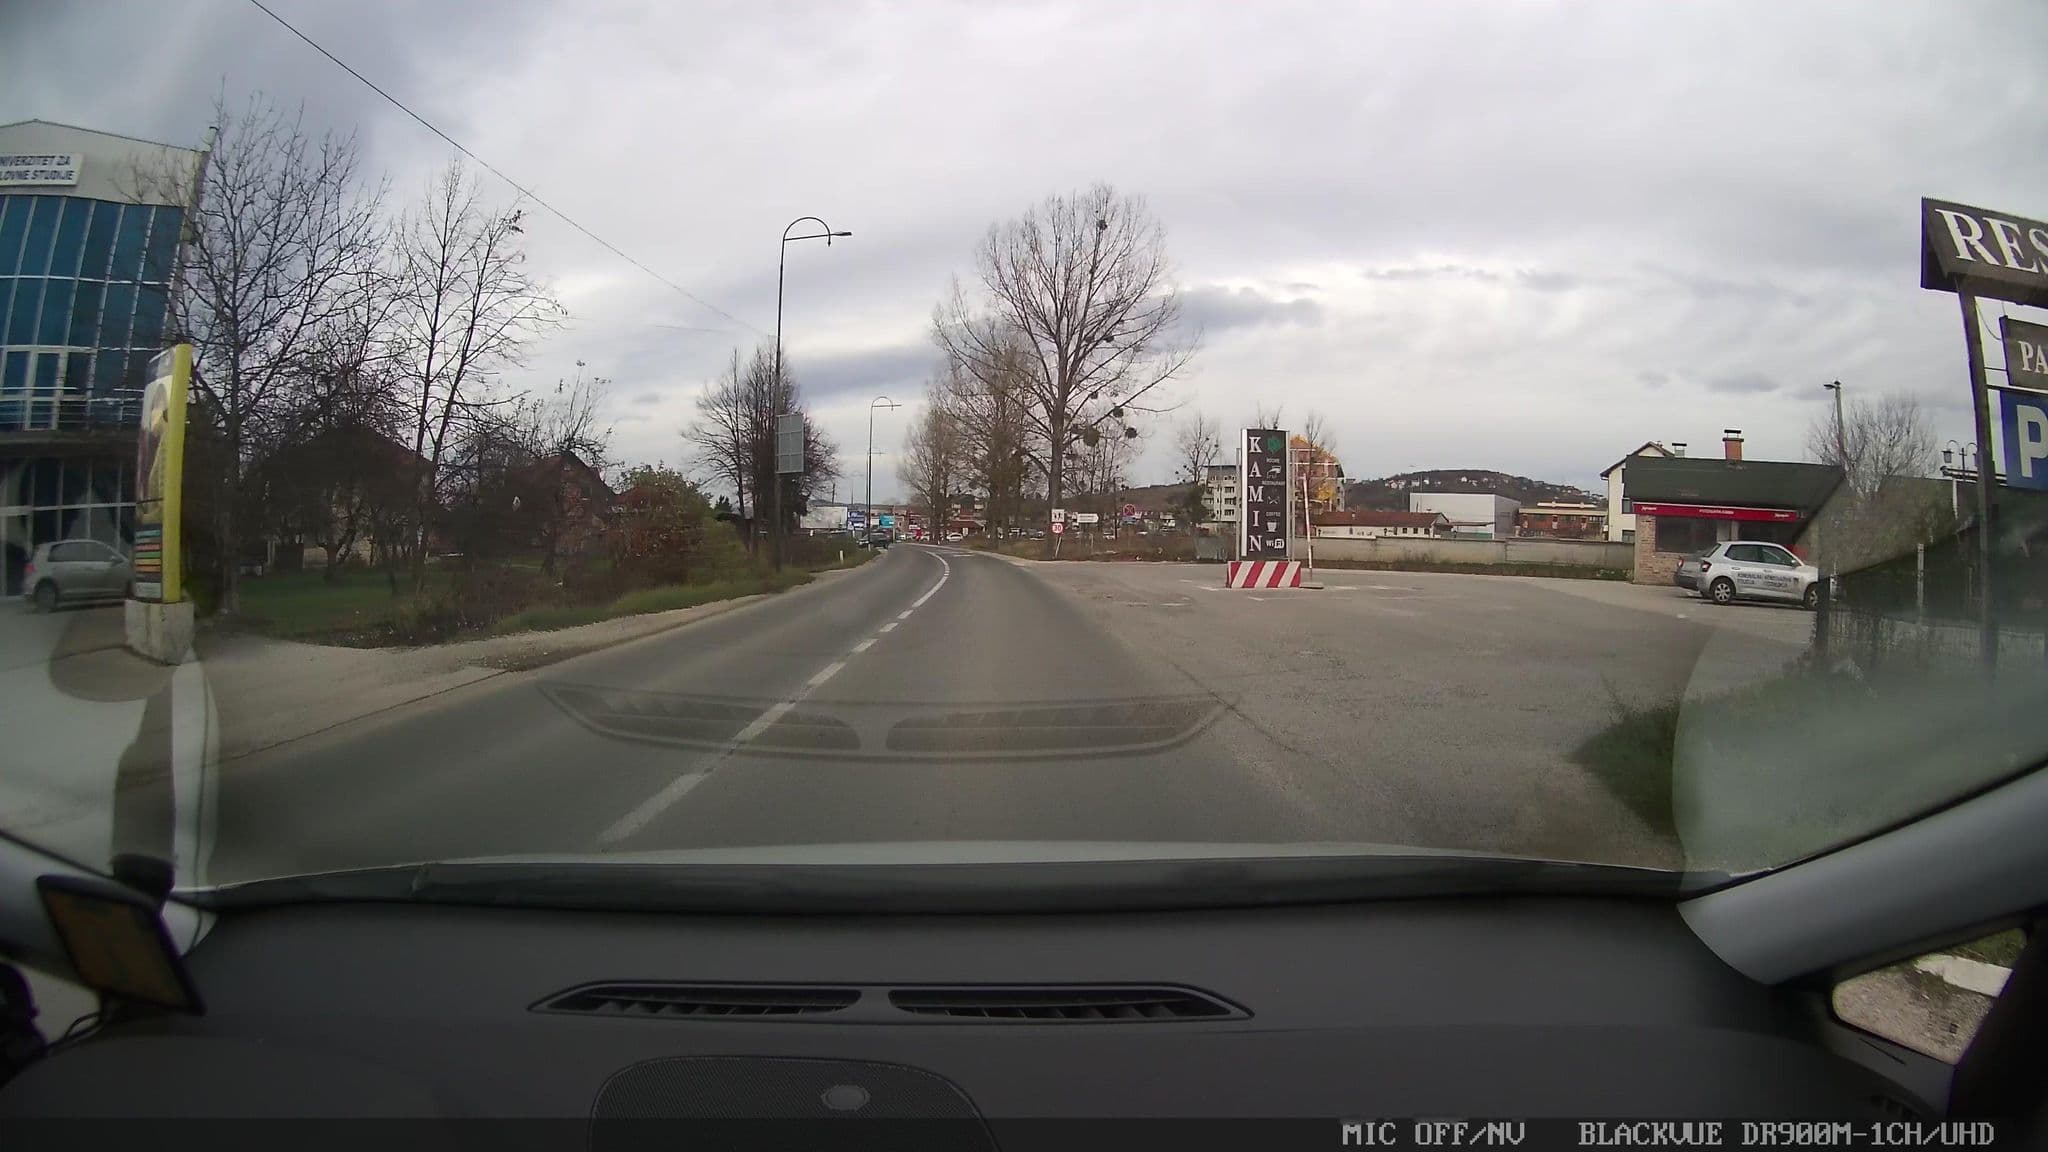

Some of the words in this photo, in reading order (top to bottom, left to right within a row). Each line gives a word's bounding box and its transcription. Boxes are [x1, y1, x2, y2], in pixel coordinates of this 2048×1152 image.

[57, 155, 70, 166] ZA
[2016, 404, 2048, 478] P
[1248, 436, 1264, 552] KAMIN
